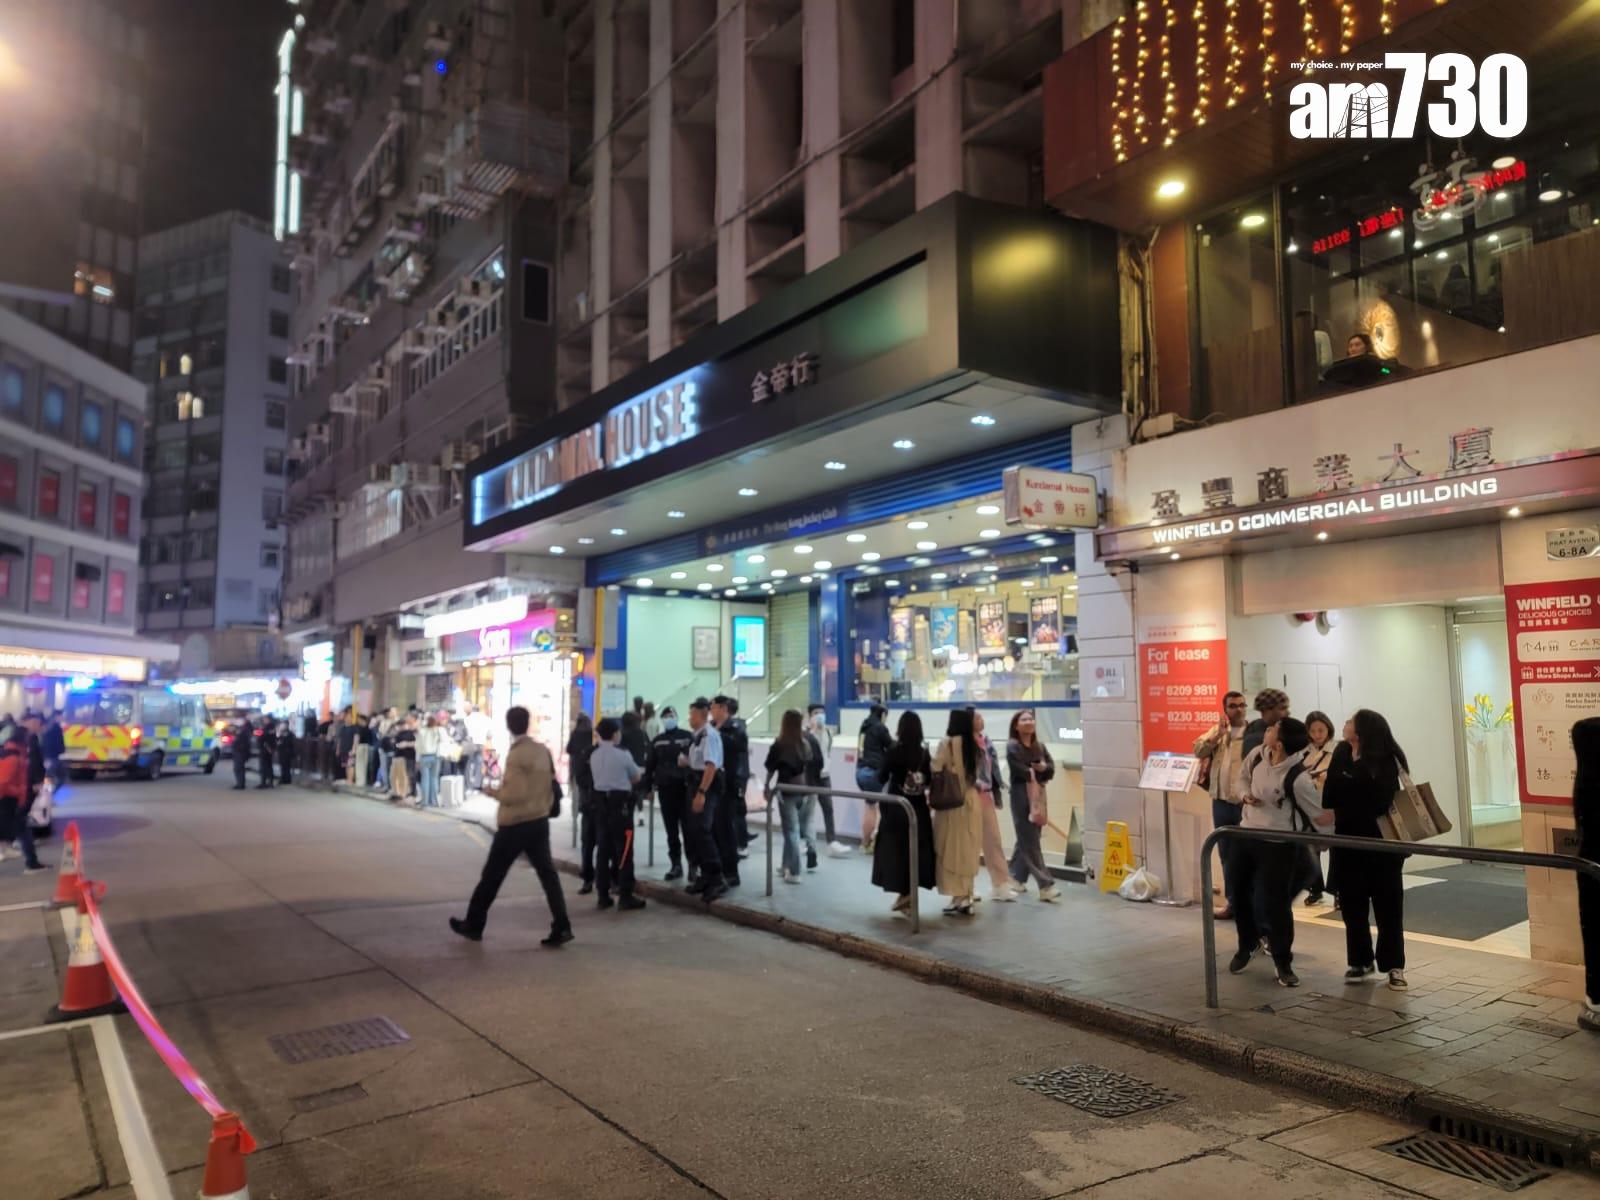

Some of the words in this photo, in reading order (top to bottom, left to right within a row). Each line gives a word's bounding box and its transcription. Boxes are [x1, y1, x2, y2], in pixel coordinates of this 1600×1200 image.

[751, 352, 811, 404] 金帝行
[605, 381, 690, 471] HOUSE
[1152, 519, 1235, 544] WINFIELD
[1238, 496, 1374, 532] COMMERCIAL
[1380, 477, 1499, 510] BUILDING
[1559, 546, 1588, 558] 6-8A
[1516, 594, 1592, 611] WINFIELD
[1518, 609, 1557, 619] DELICIOUS
[1557, 608, 1592, 617] CHOICES
[1147, 648, 1169, 661] For
[1174, 647, 1210, 661] lease
[1148, 662, 1169, 675] 出租
[1166, 685, 1193, 696] 8209
[1193, 684, 1218, 696] 9811
